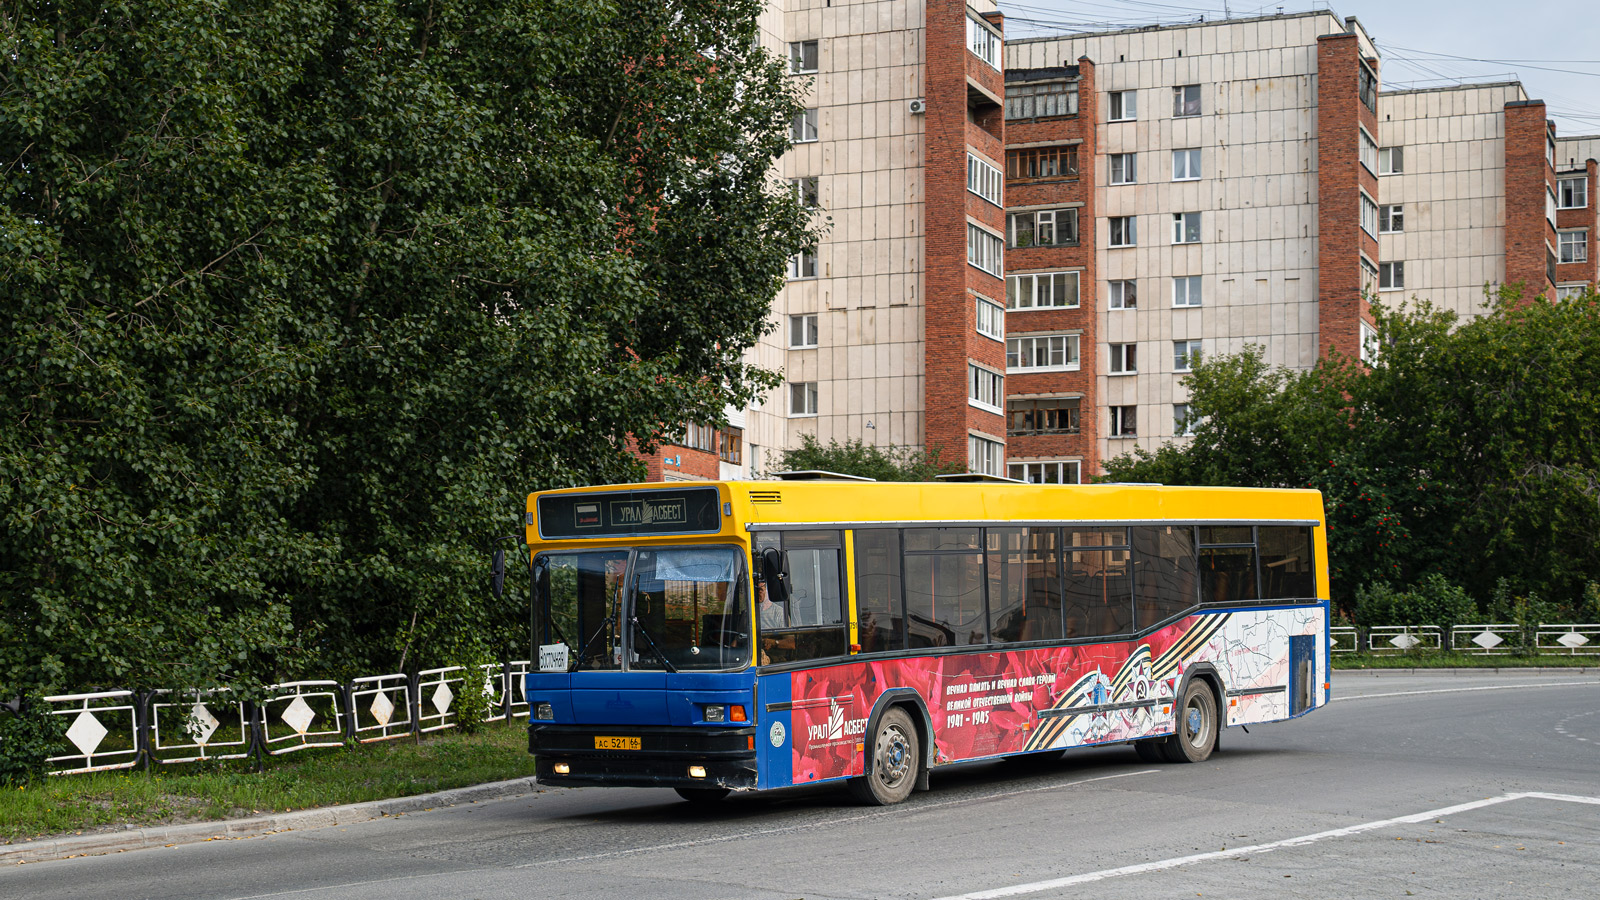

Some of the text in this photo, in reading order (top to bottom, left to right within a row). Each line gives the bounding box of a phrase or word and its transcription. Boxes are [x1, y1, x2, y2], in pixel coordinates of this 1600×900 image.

[620, 504, 681, 522] УРАЛ АСБЕСТ
[946, 674, 1056, 695] ВЕЧНАЯ ПАМЯТЬ И ВЕЧНАЯ СЛАВА ГЕРОЯМ
[946, 690, 1033, 711] ВЕЛИКОЙ ОТЕЧЕСТВЕННОЙ ВОЙНЫ
[808, 718, 868, 741] УРАЛ АСБЕСТ
[947, 714, 964, 729] 1941
[972, 710, 990, 726] 1945
[611, 738, 626, 748] 521
[630, 738, 638, 746] 66
